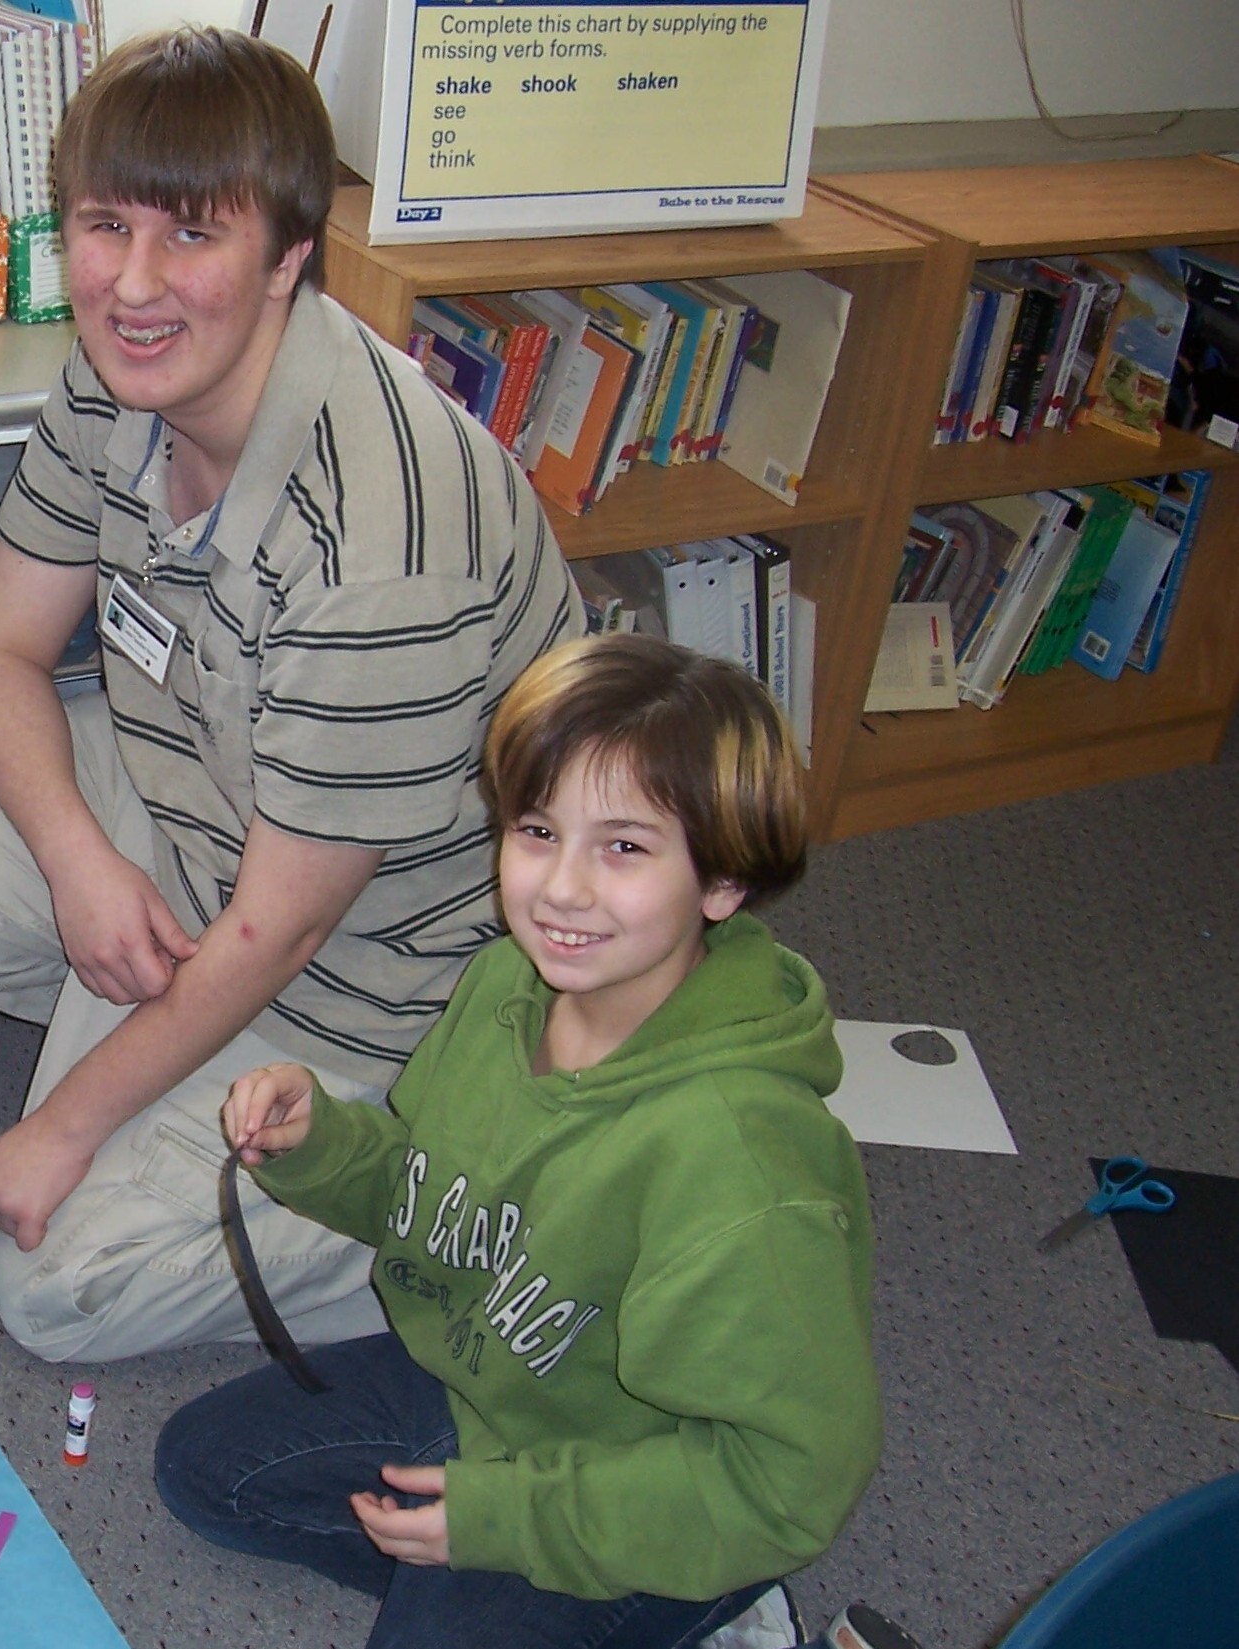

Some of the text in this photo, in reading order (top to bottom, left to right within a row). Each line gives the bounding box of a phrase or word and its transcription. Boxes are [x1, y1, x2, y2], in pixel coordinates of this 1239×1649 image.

[440, 13, 768, 36] Complete this chart by supplying the
[421, 39, 608, 63] missing verb forms.
[435, 73, 679, 96] shake shook shaken
[433, 103, 466, 120] see
[431, 129, 456, 148] go
[429, 149, 476, 169] think
[659, 194, 786, 207] Babe to the Rescue
[399, 209, 430, 220] Day
[774, 636, 786, 671] School
